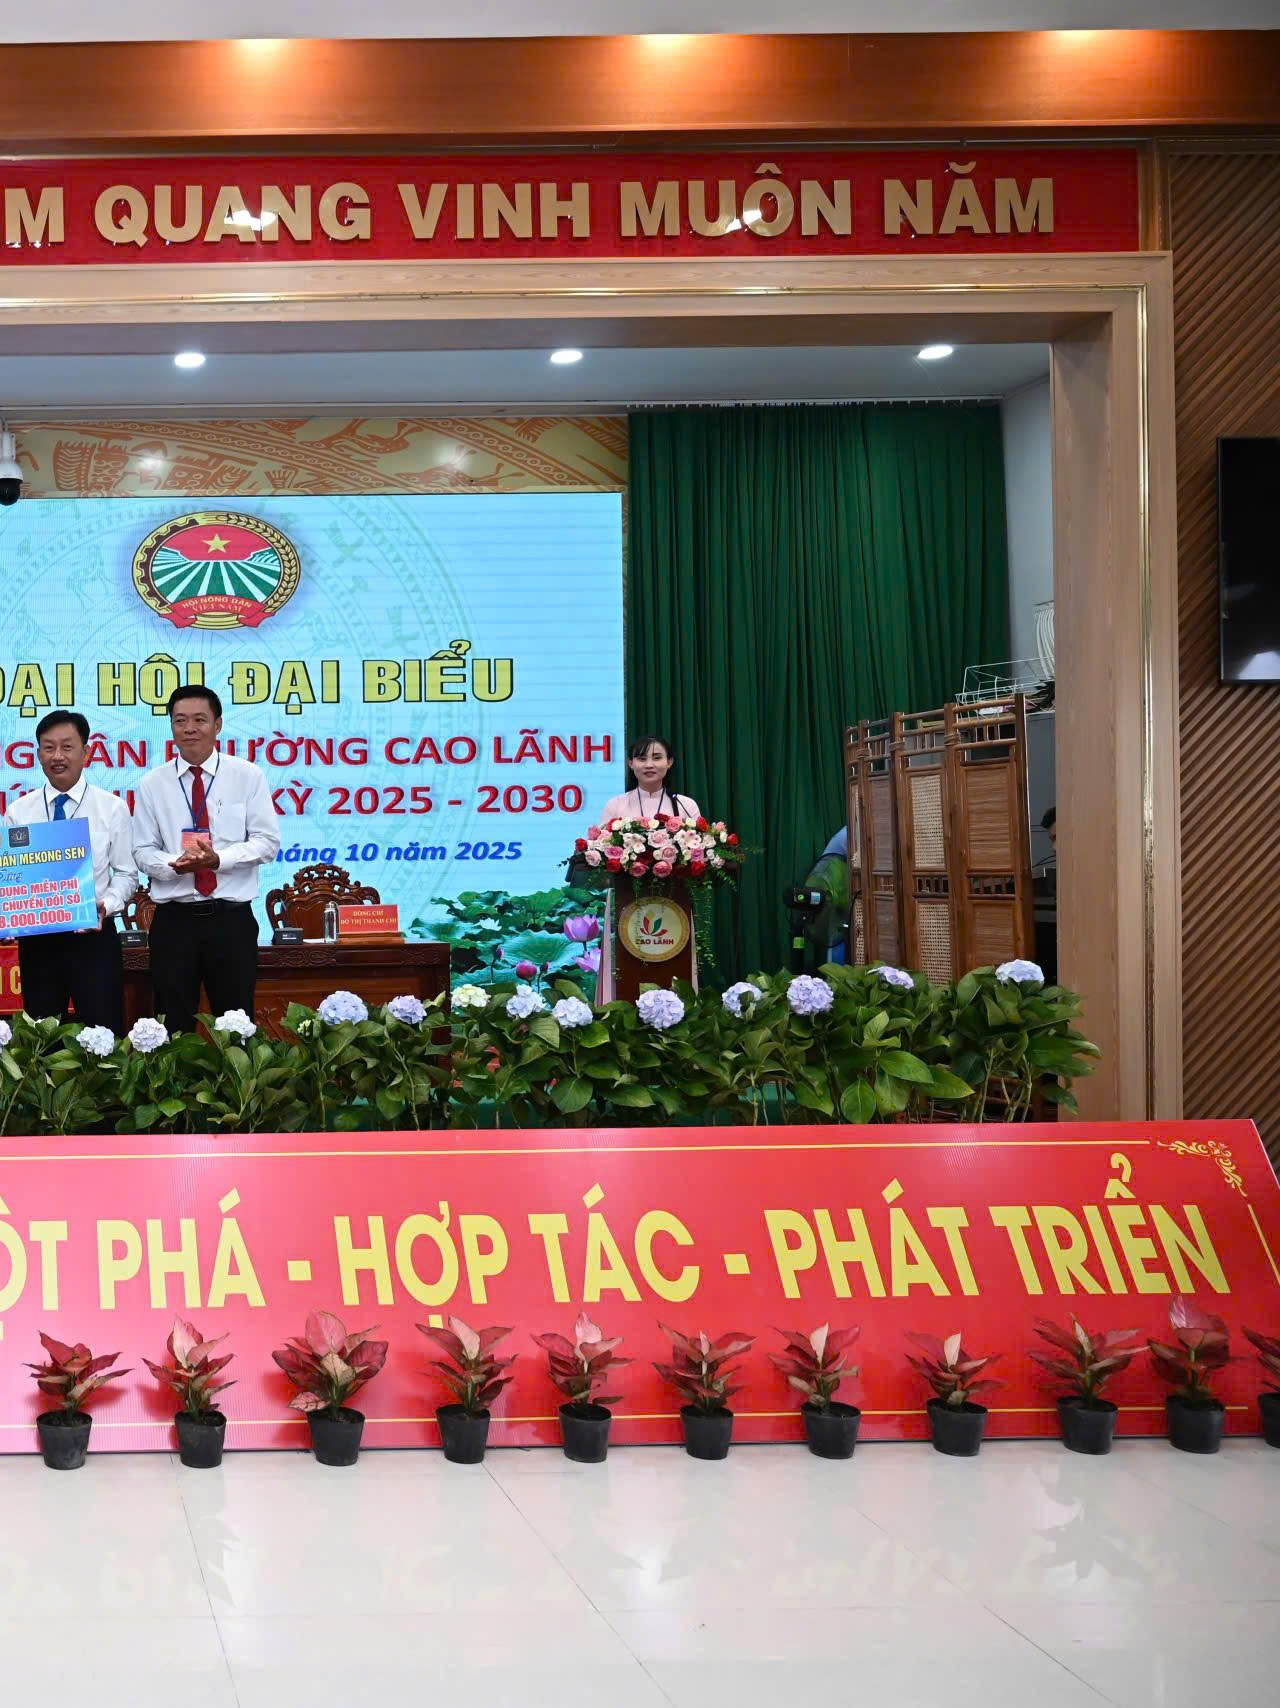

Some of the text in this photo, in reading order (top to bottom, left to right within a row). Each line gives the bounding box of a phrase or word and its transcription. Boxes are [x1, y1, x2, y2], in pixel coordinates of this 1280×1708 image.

[94, 182, 371, 249] QUANG
[398, 183, 591, 240] VINH
[620, 162, 851, 237] MUÔN
[884, 161, 1053, 236] NĂM
[228, 660, 341, 715] ĐẠI
[362, 639, 515, 703] BIỂU
[82, 733, 147, 767] ÂN
[385, 736, 476, 765] CAO
[493, 729, 611, 763] LÃNH
[327, 786, 433, 814] 2025
[477, 784, 582, 813] 2030
[19, 849, 62, 865] MEKONG
[65, 847, 86, 860] SEN
[345, 843, 380, 861] 10
[385, 842, 447, 861] năm
[454, 842, 522, 860] 2025
[96, 1187, 267, 1310] PHÁ
[287, 1260, 312, 1281] -
[334, 1200, 508, 1328] HỢP
[527, 1183, 700, 1303] TÁC
[723, 1253, 751, 1275] -
[763, 1177, 980, 1299] PHÁT
[988, 1152, 1231, 1295] TRIỂN
